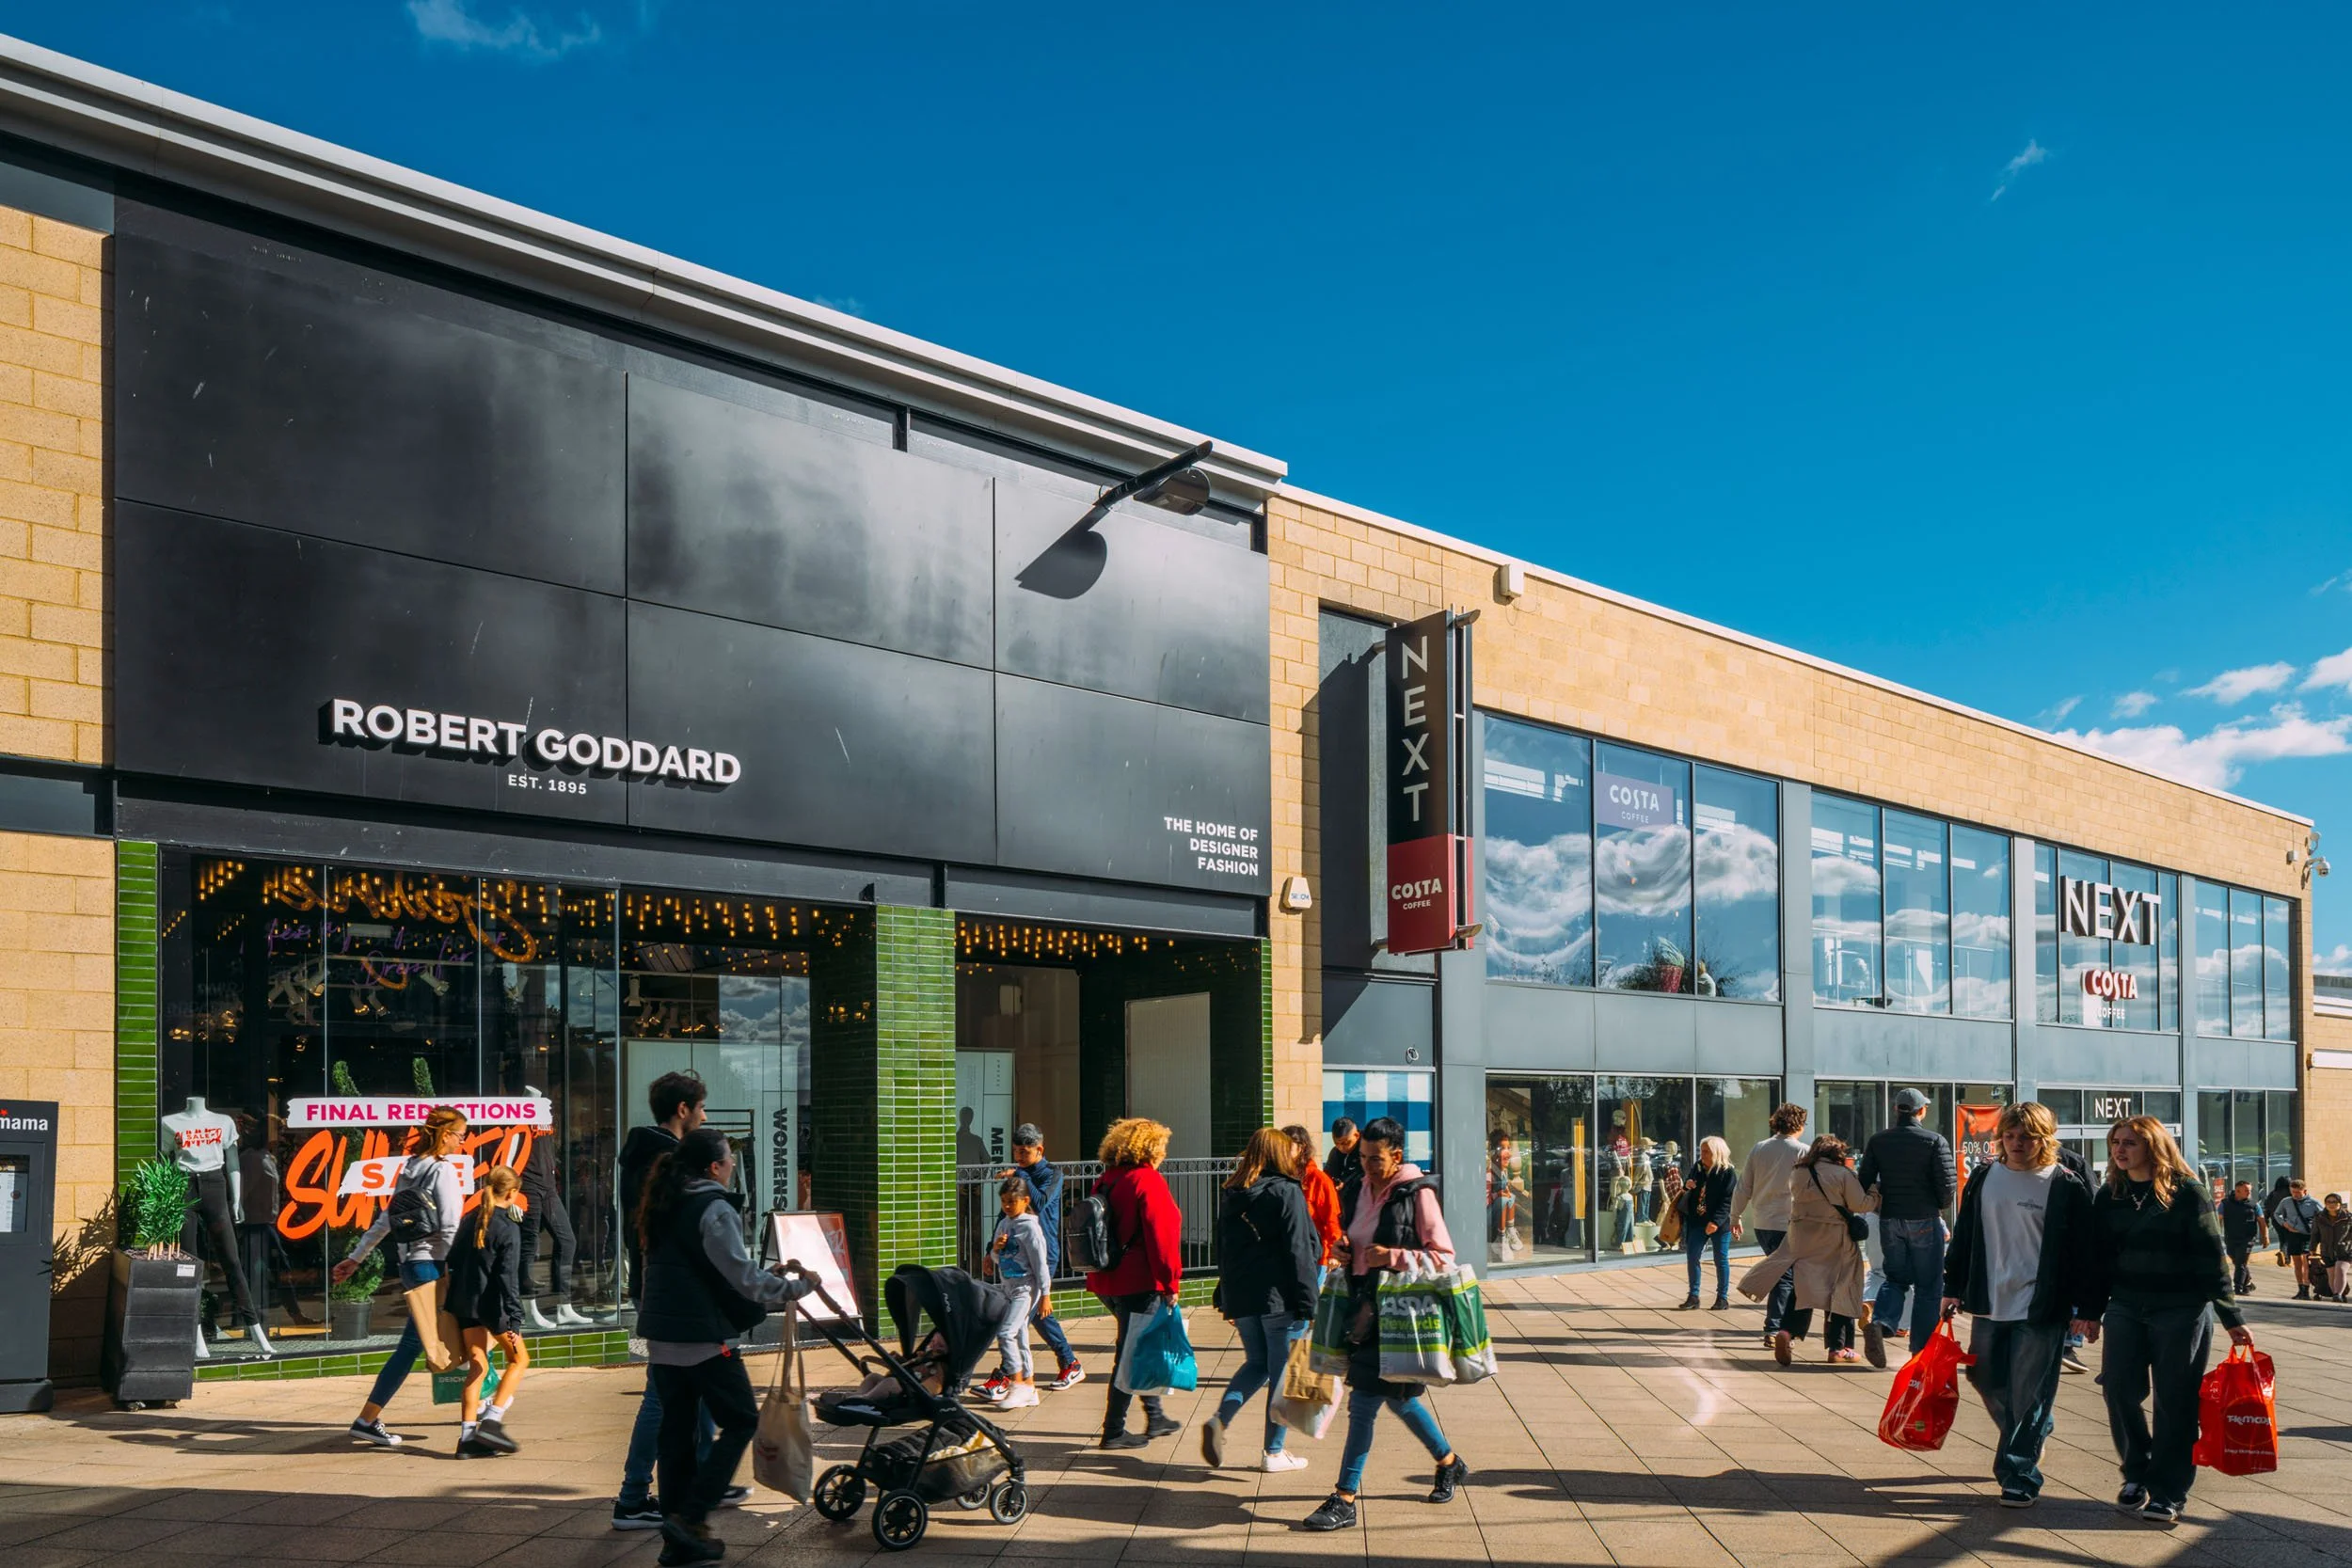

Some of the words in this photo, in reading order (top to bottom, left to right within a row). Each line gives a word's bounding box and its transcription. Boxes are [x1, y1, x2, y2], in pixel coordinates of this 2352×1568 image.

[1402, 636, 1429, 822] NEXT
[330, 698, 527, 756] ROBERT
[535, 728, 741, 784] GODDARD
[508, 774, 542, 789] EST.
[548, 779, 587, 795] 1895
[1610, 784, 1660, 812] COSTA
[1621, 811, 1649, 824] COFFEE
[1164, 816, 1192, 832] THE
[1196, 821, 1236, 839] HOME
[1239, 828, 1259, 841] OF
[1189, 838, 1259, 859] DESIGNER
[1198, 857, 1259, 876] FASHION
[1391, 878, 1442, 900] COSTA
[1403, 900, 1431, 910] COFFEE
[2063, 876, 2161, 945] NEXT
[2090, 970, 2137, 1001] COSTA
[2097, 1007, 2125, 1020] COFFEE
[307, 1104, 378, 1120] FINAL
[388, 1103, 536, 1119] REDTIONS
[2094, 1098, 2131, 1118] NEXT
[1963, 1141, 1981, 1154] 50%
[773, 1107, 787, 1212] WOMENS
[361, 1162, 465, 1190] SE
[1379, 1295, 1439, 1316] ASDA
[1380, 1317, 1441, 1330] Rewrds
